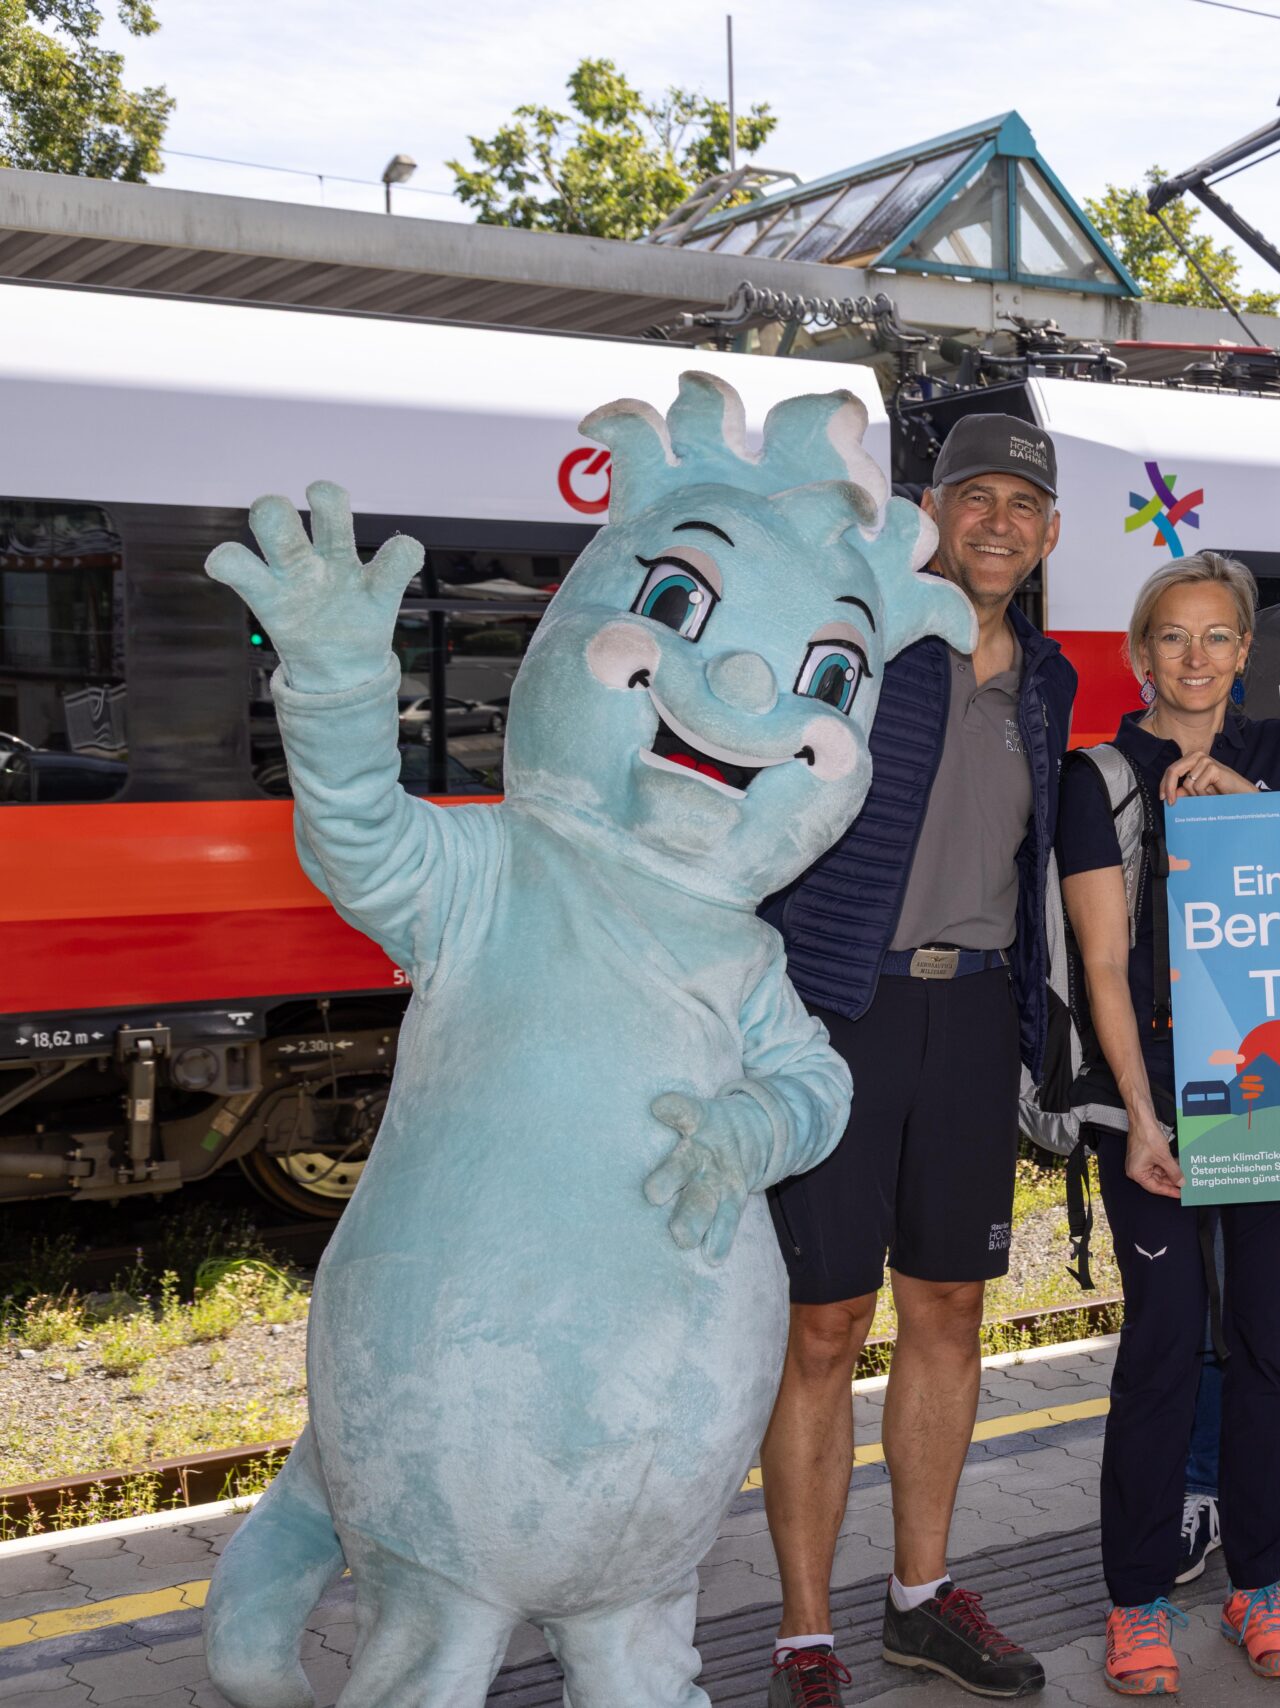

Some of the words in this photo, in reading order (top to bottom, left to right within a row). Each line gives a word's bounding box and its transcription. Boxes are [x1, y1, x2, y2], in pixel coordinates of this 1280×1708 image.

[32, 1030, 72, 1049] 18,62
[74, 1032, 89, 1045] m
[1190, 1154, 1207, 1164] Mit
[1209, 1154, 1231, 1164] dem
[1190, 1164, 1273, 1176] Österreichischen
[1191, 1176, 1251, 1188] Bergbahnen
